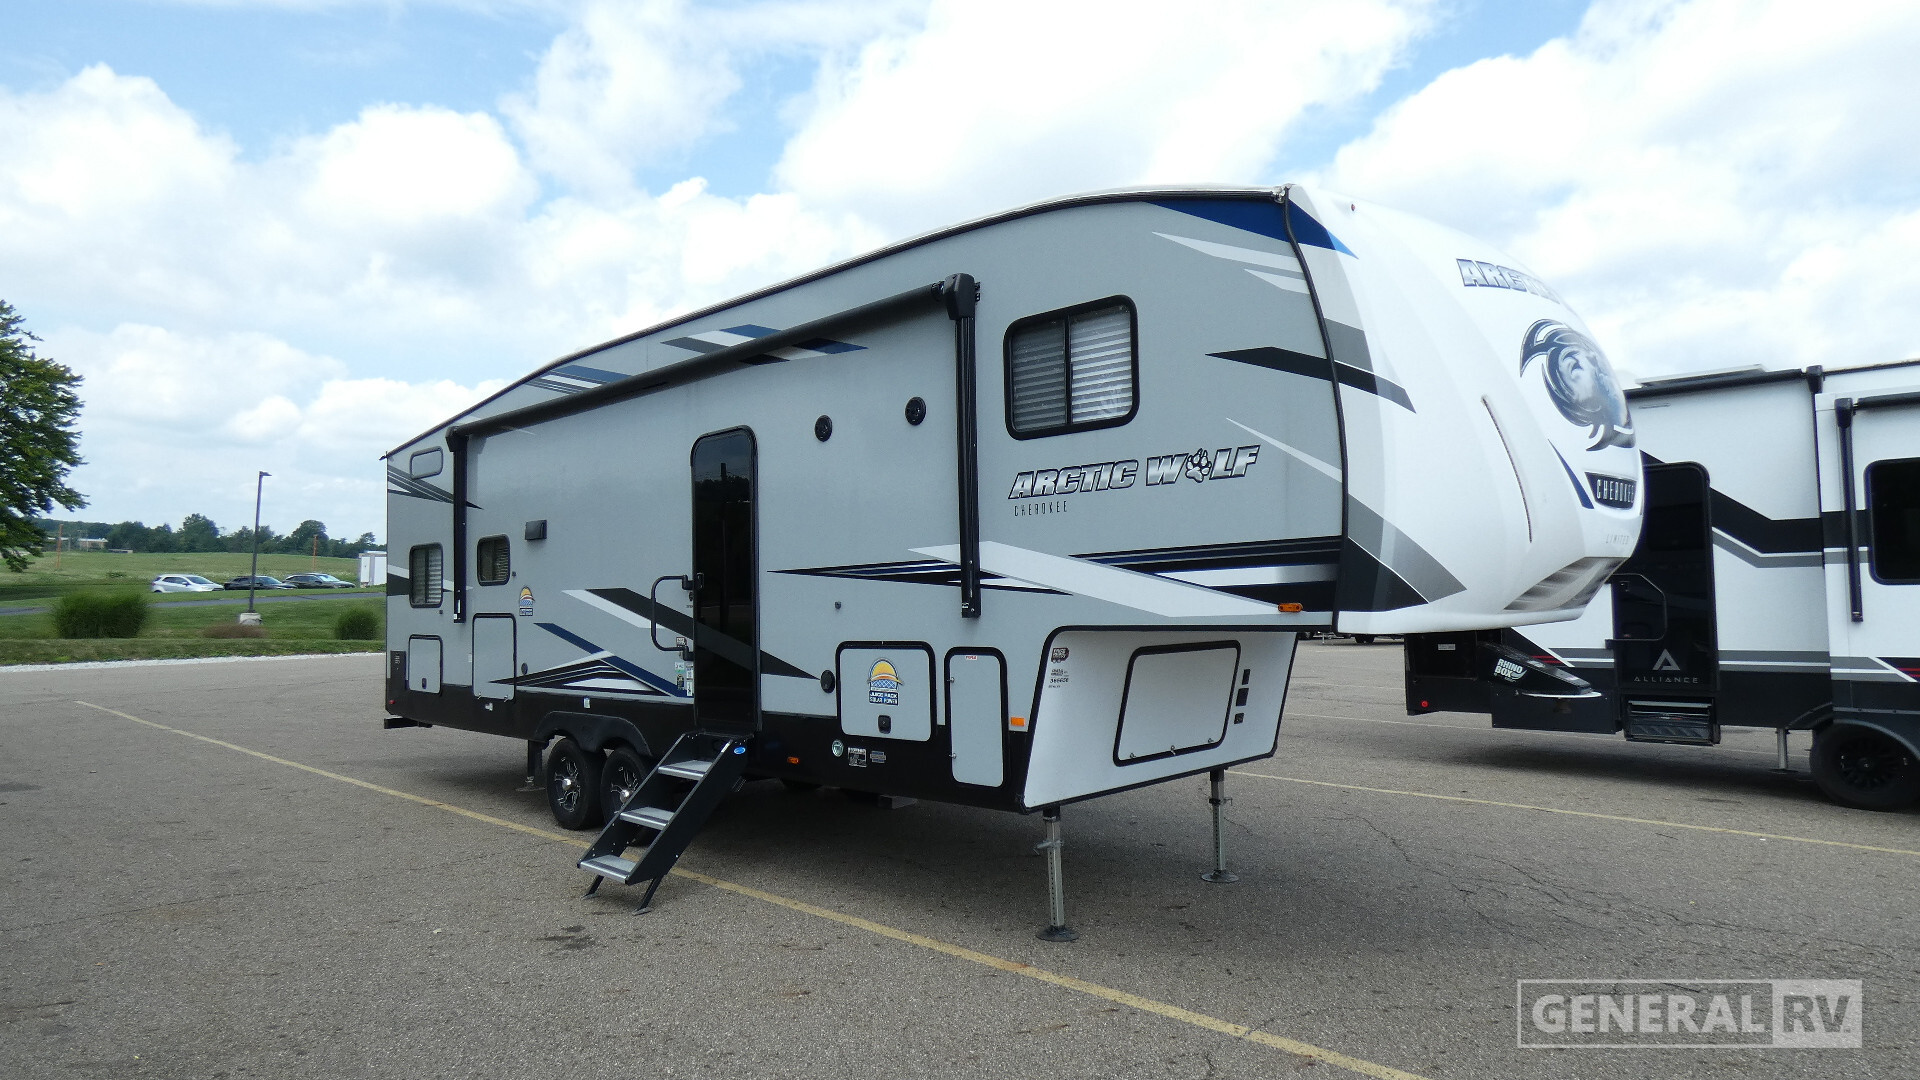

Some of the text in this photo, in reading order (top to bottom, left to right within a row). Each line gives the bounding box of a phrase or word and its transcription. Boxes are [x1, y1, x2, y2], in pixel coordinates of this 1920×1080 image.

[1007, 459, 1139, 500] ARCTIC
[1014, 500, 1068, 517] CHEROKEE
[1494, 665, 1513, 678] BOX
[1497, 658, 1523, 674] RHINO
[1633, 676, 1699, 684] ALLIANCE
